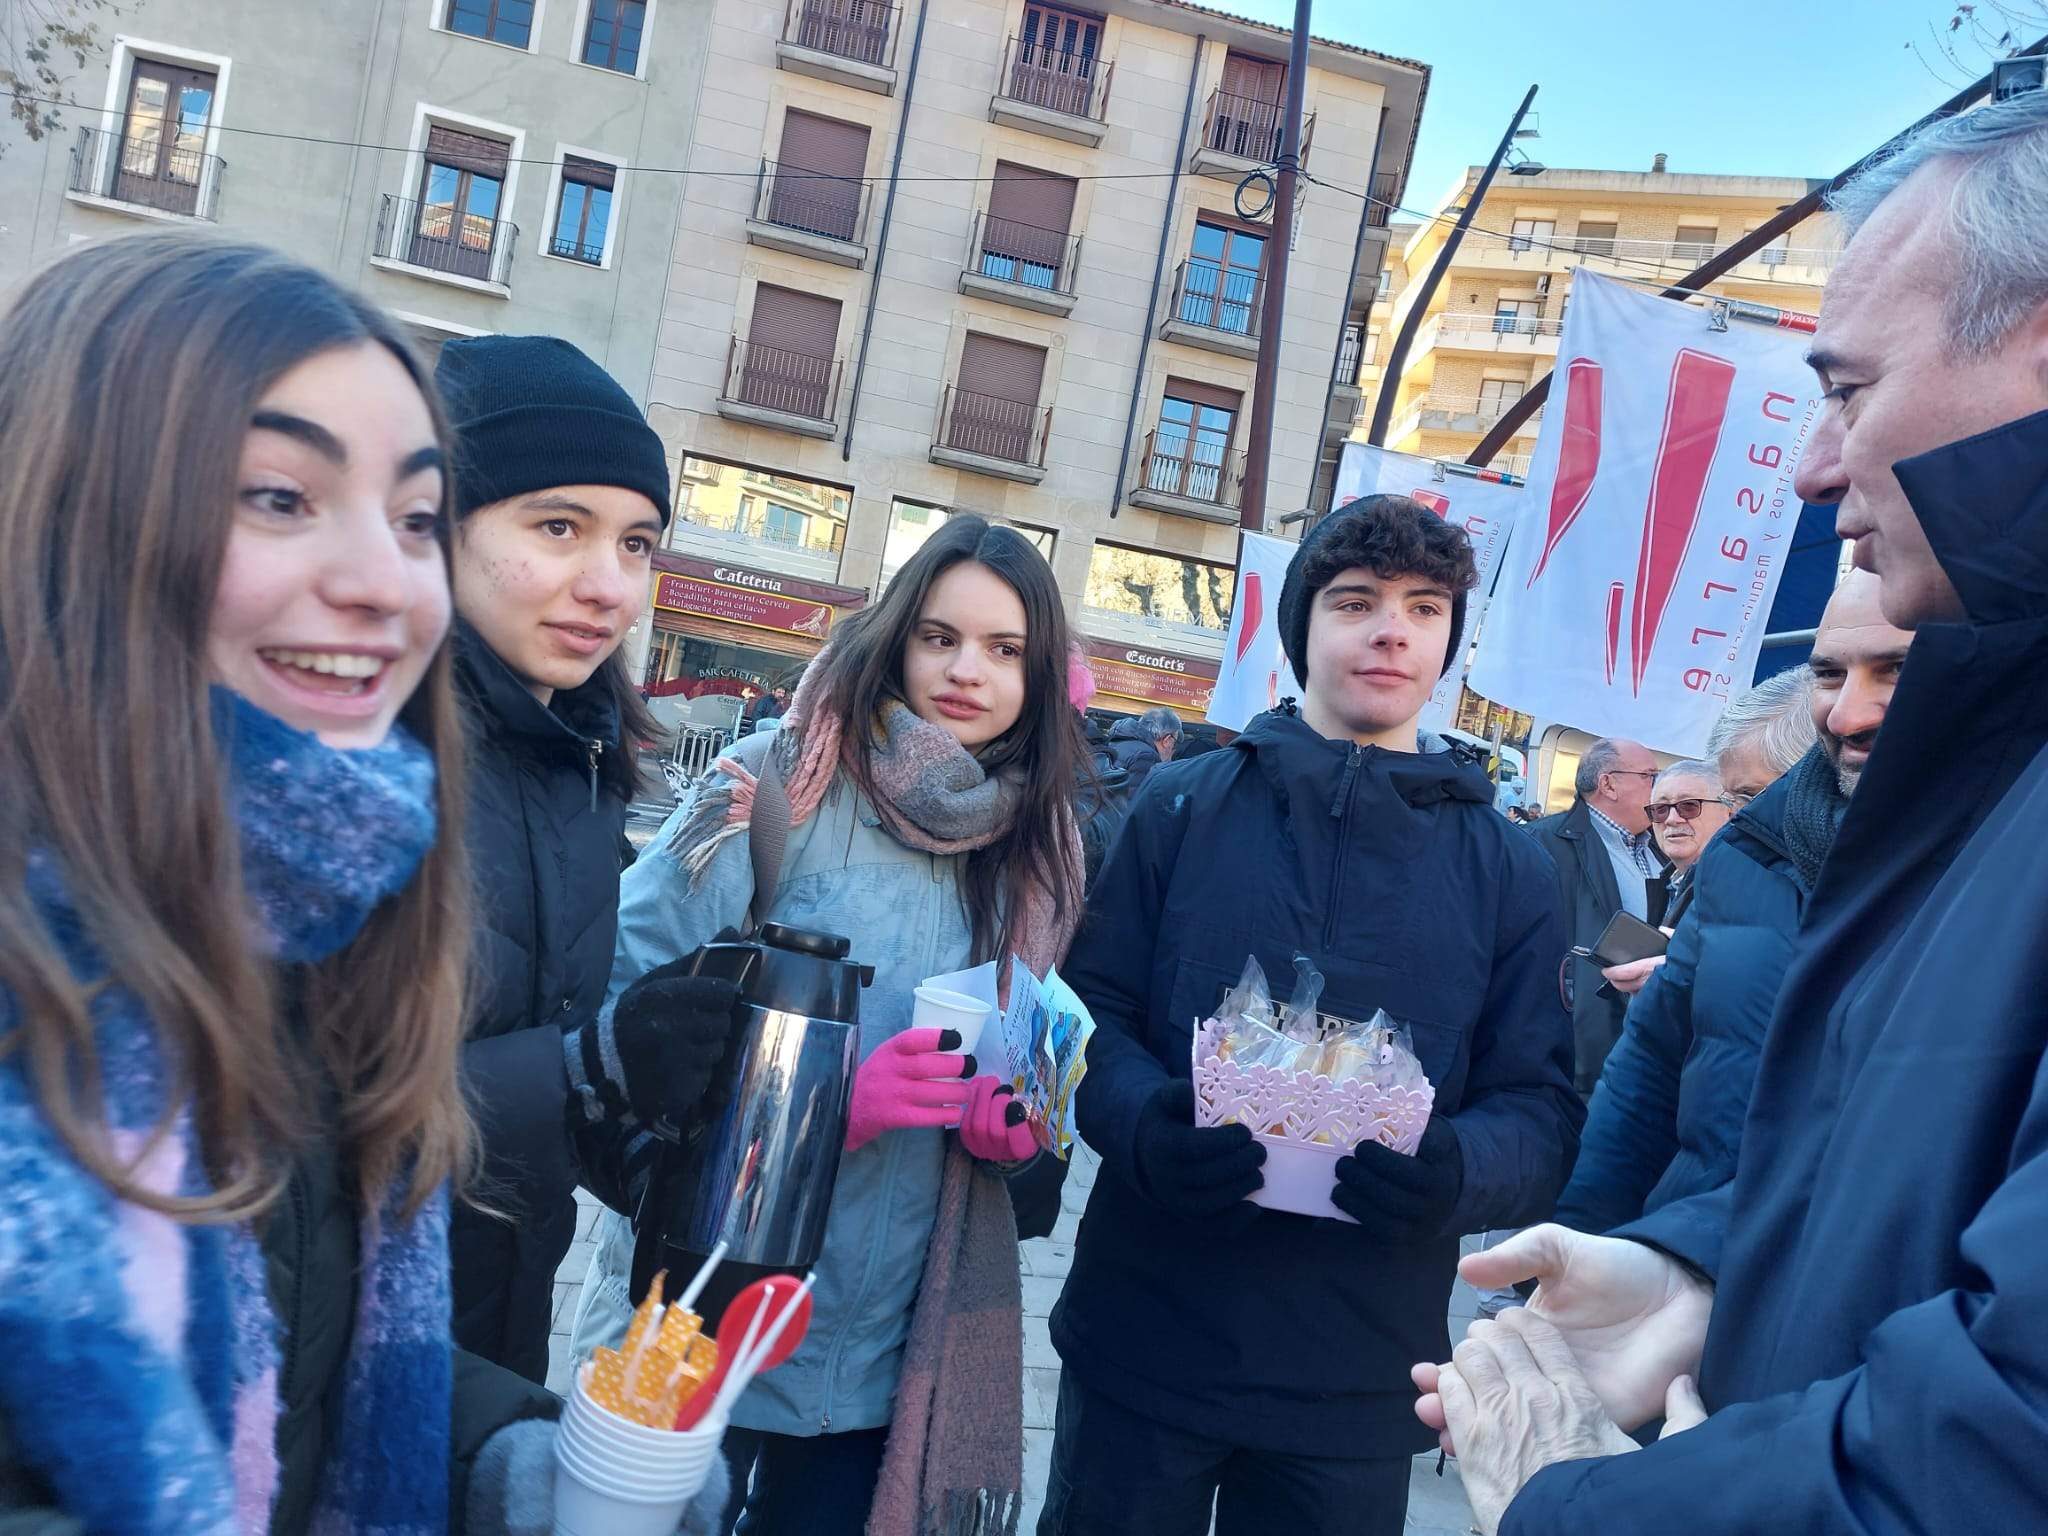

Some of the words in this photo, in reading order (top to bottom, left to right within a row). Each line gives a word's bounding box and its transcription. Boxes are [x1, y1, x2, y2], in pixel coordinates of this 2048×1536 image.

[713, 567, 783, 592] Cafeteria
[669, 589, 712, 604] Bocadillos
[712, 598, 733, 609] para
[716, 608, 753, 622] Campera
[1151, 674, 1186, 687] Sandwich
